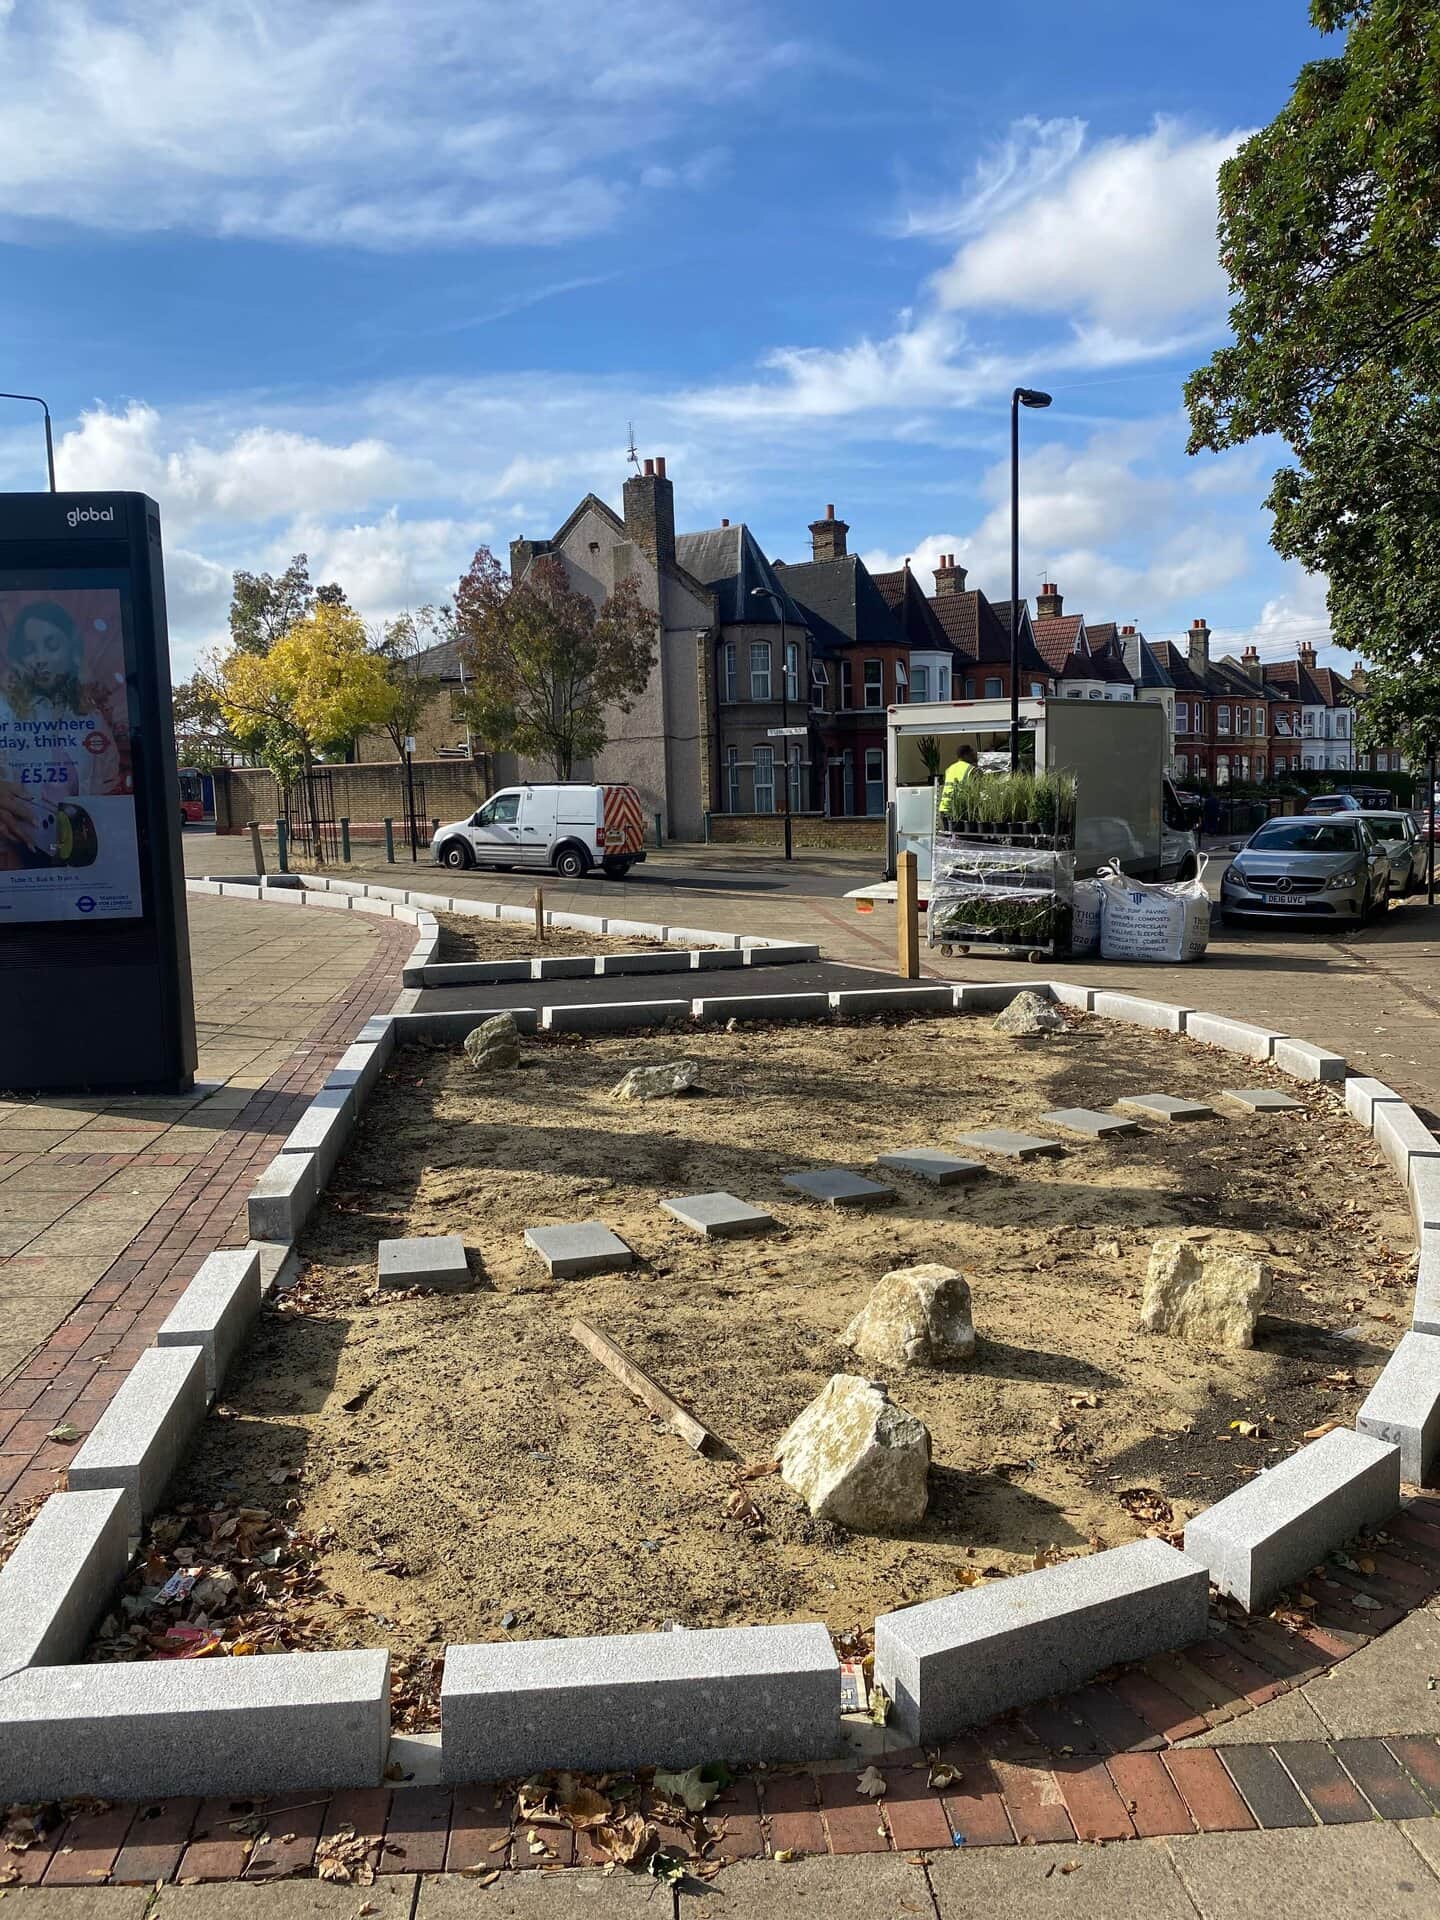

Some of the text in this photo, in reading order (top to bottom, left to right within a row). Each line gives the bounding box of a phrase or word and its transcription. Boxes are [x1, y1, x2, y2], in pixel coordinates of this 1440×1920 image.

[66, 506, 114, 527] global
[14, 718, 96, 734] anywhere
[34, 735, 77, 748] think
[21, 767, 69, 784] £5.25
